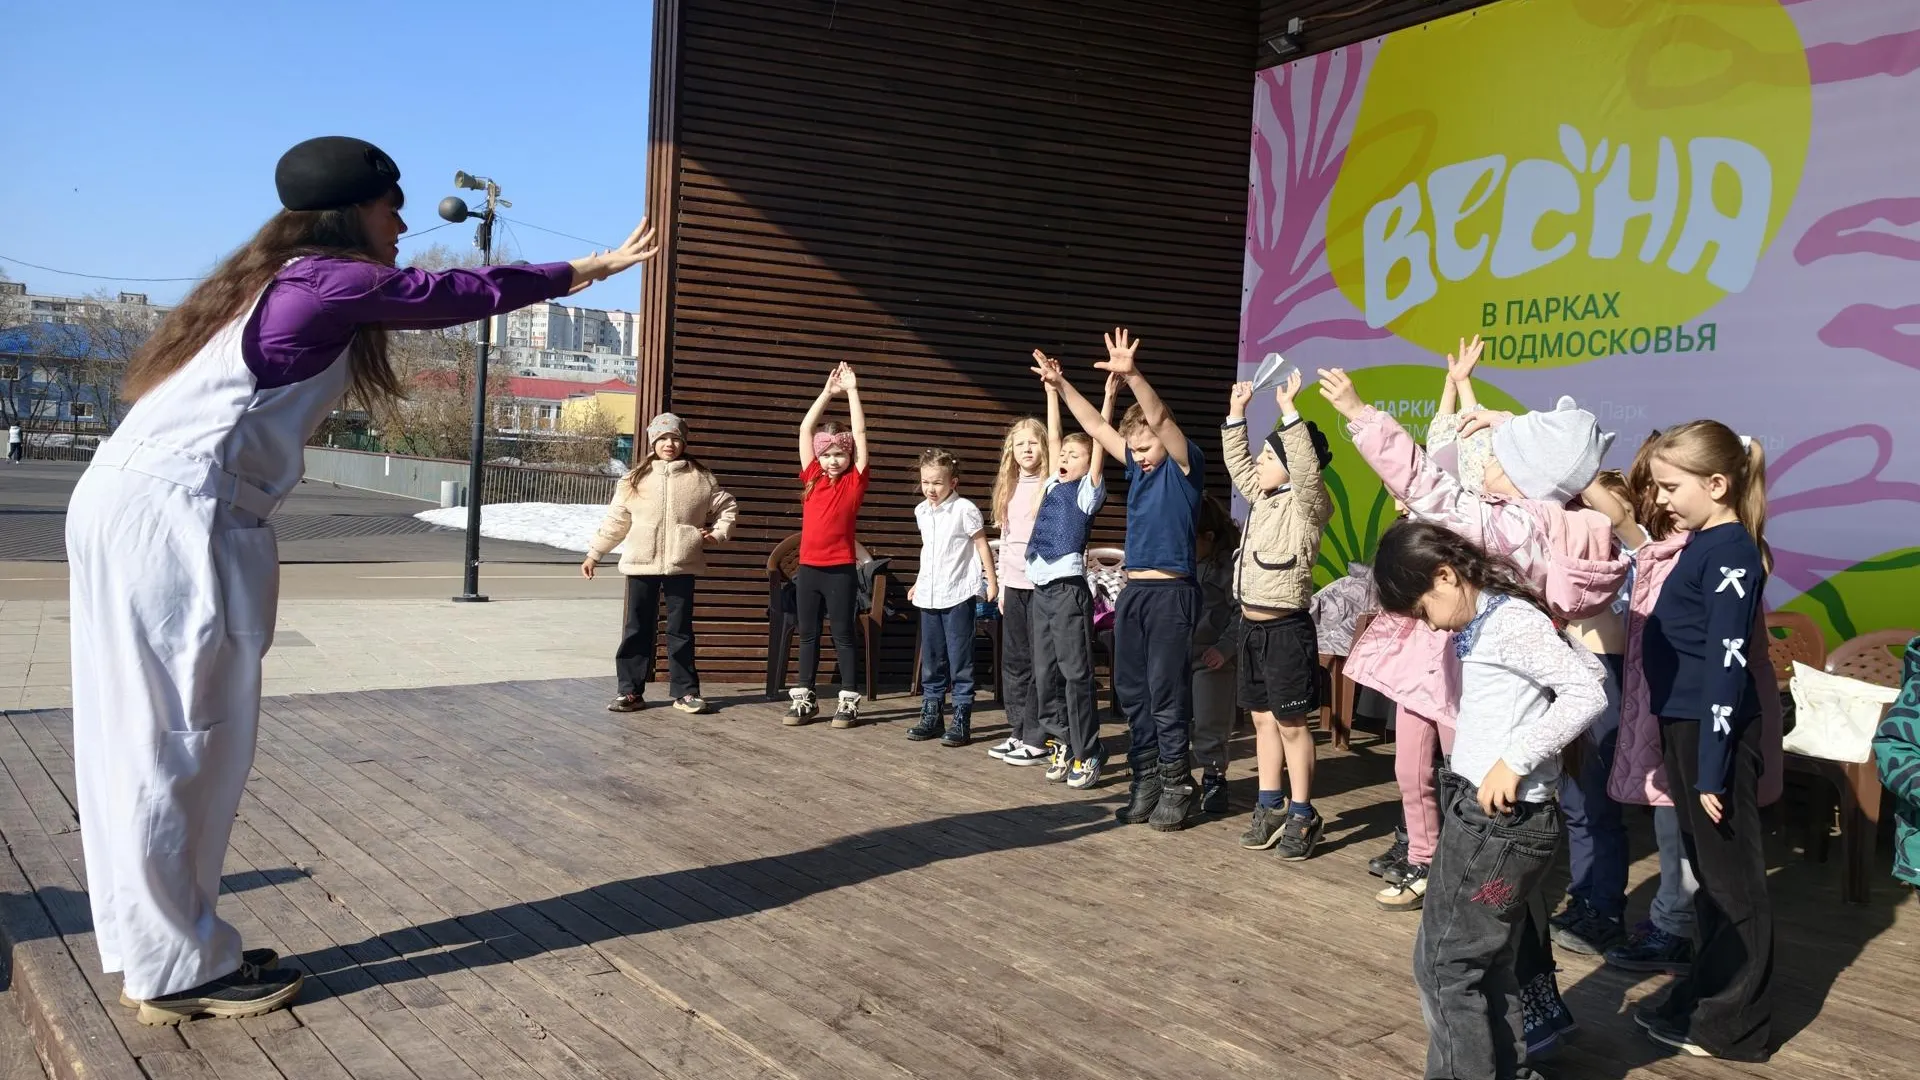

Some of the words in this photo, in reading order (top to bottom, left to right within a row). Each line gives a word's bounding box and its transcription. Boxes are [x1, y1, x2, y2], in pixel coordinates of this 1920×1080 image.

[1482, 302, 1498, 327] В
[1506, 291, 1621, 326] ПАРКАХ
[1480, 322, 1718, 365] ПОДМОСКОВЬЯ
[1600, 400, 1649, 424] Парк
